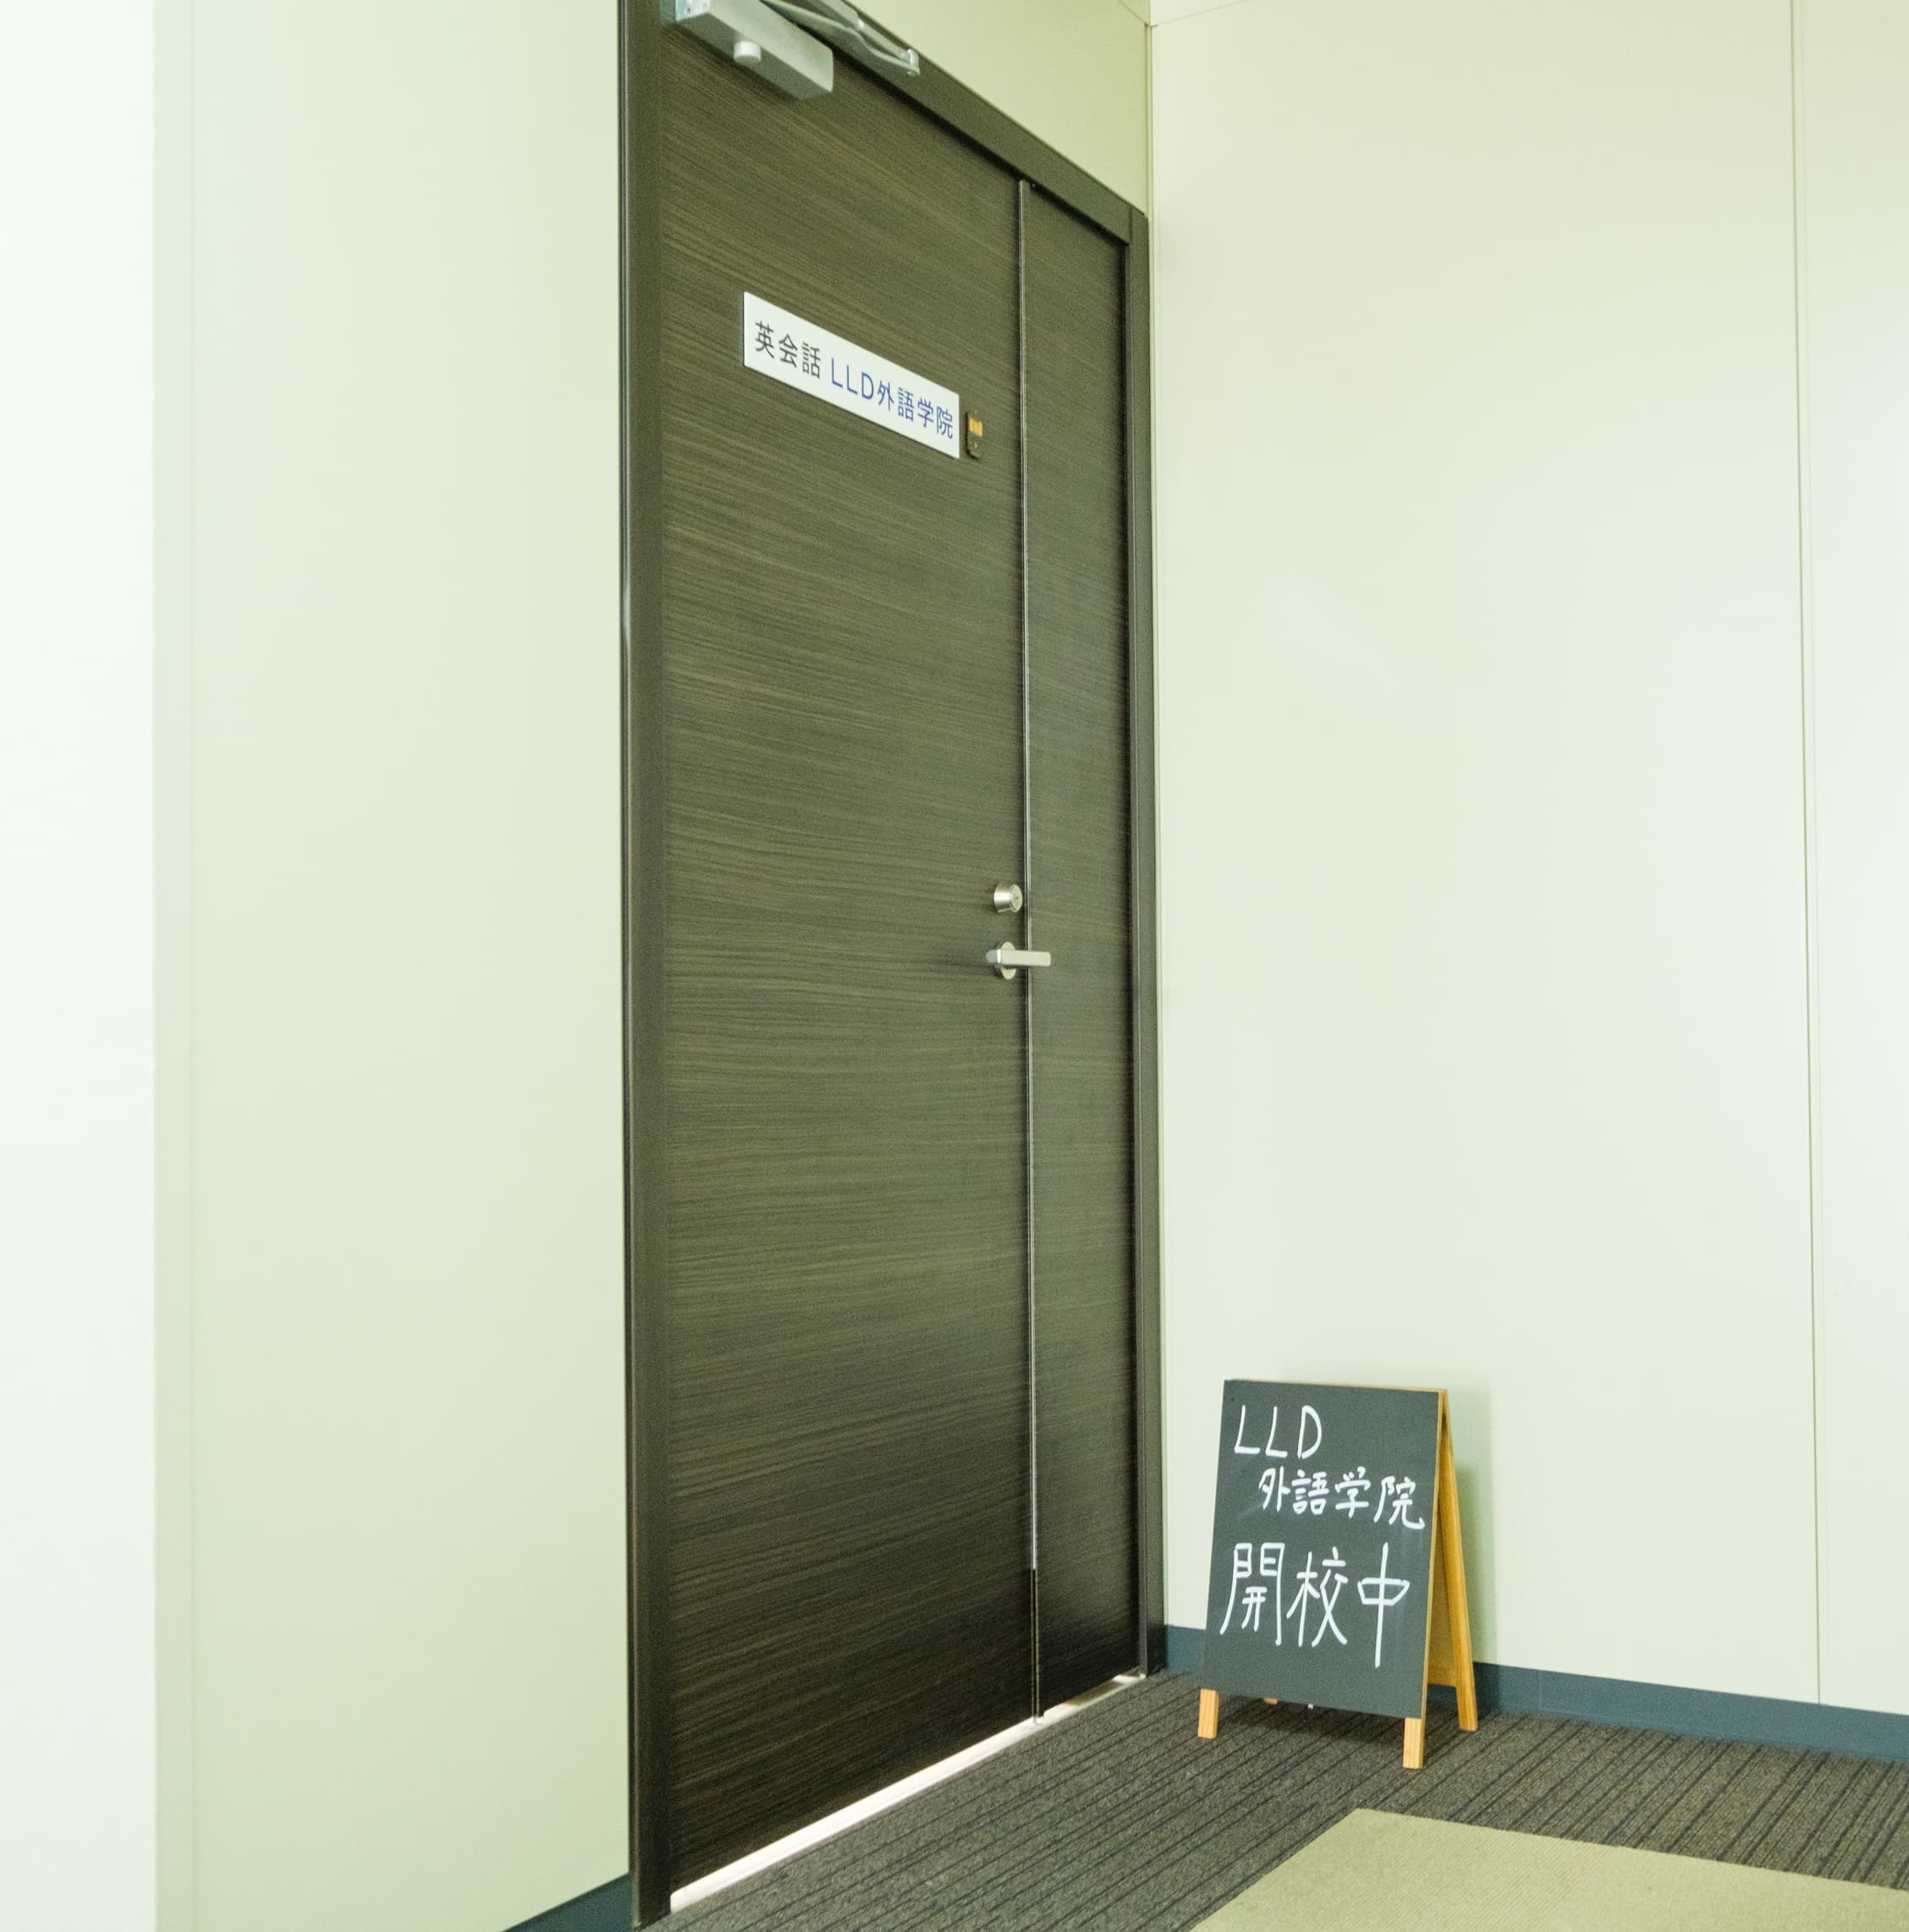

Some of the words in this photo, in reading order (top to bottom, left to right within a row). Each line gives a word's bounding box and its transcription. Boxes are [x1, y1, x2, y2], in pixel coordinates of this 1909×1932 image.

[755, 321, 821, 379] 英会話
[831, 358, 954, 439] LLD外語学院
[1234, 1405, 1323, 1459] LLD
[1258, 1465, 1425, 1530] 外語学院
[1219, 1542, 1411, 1669] 開校中
